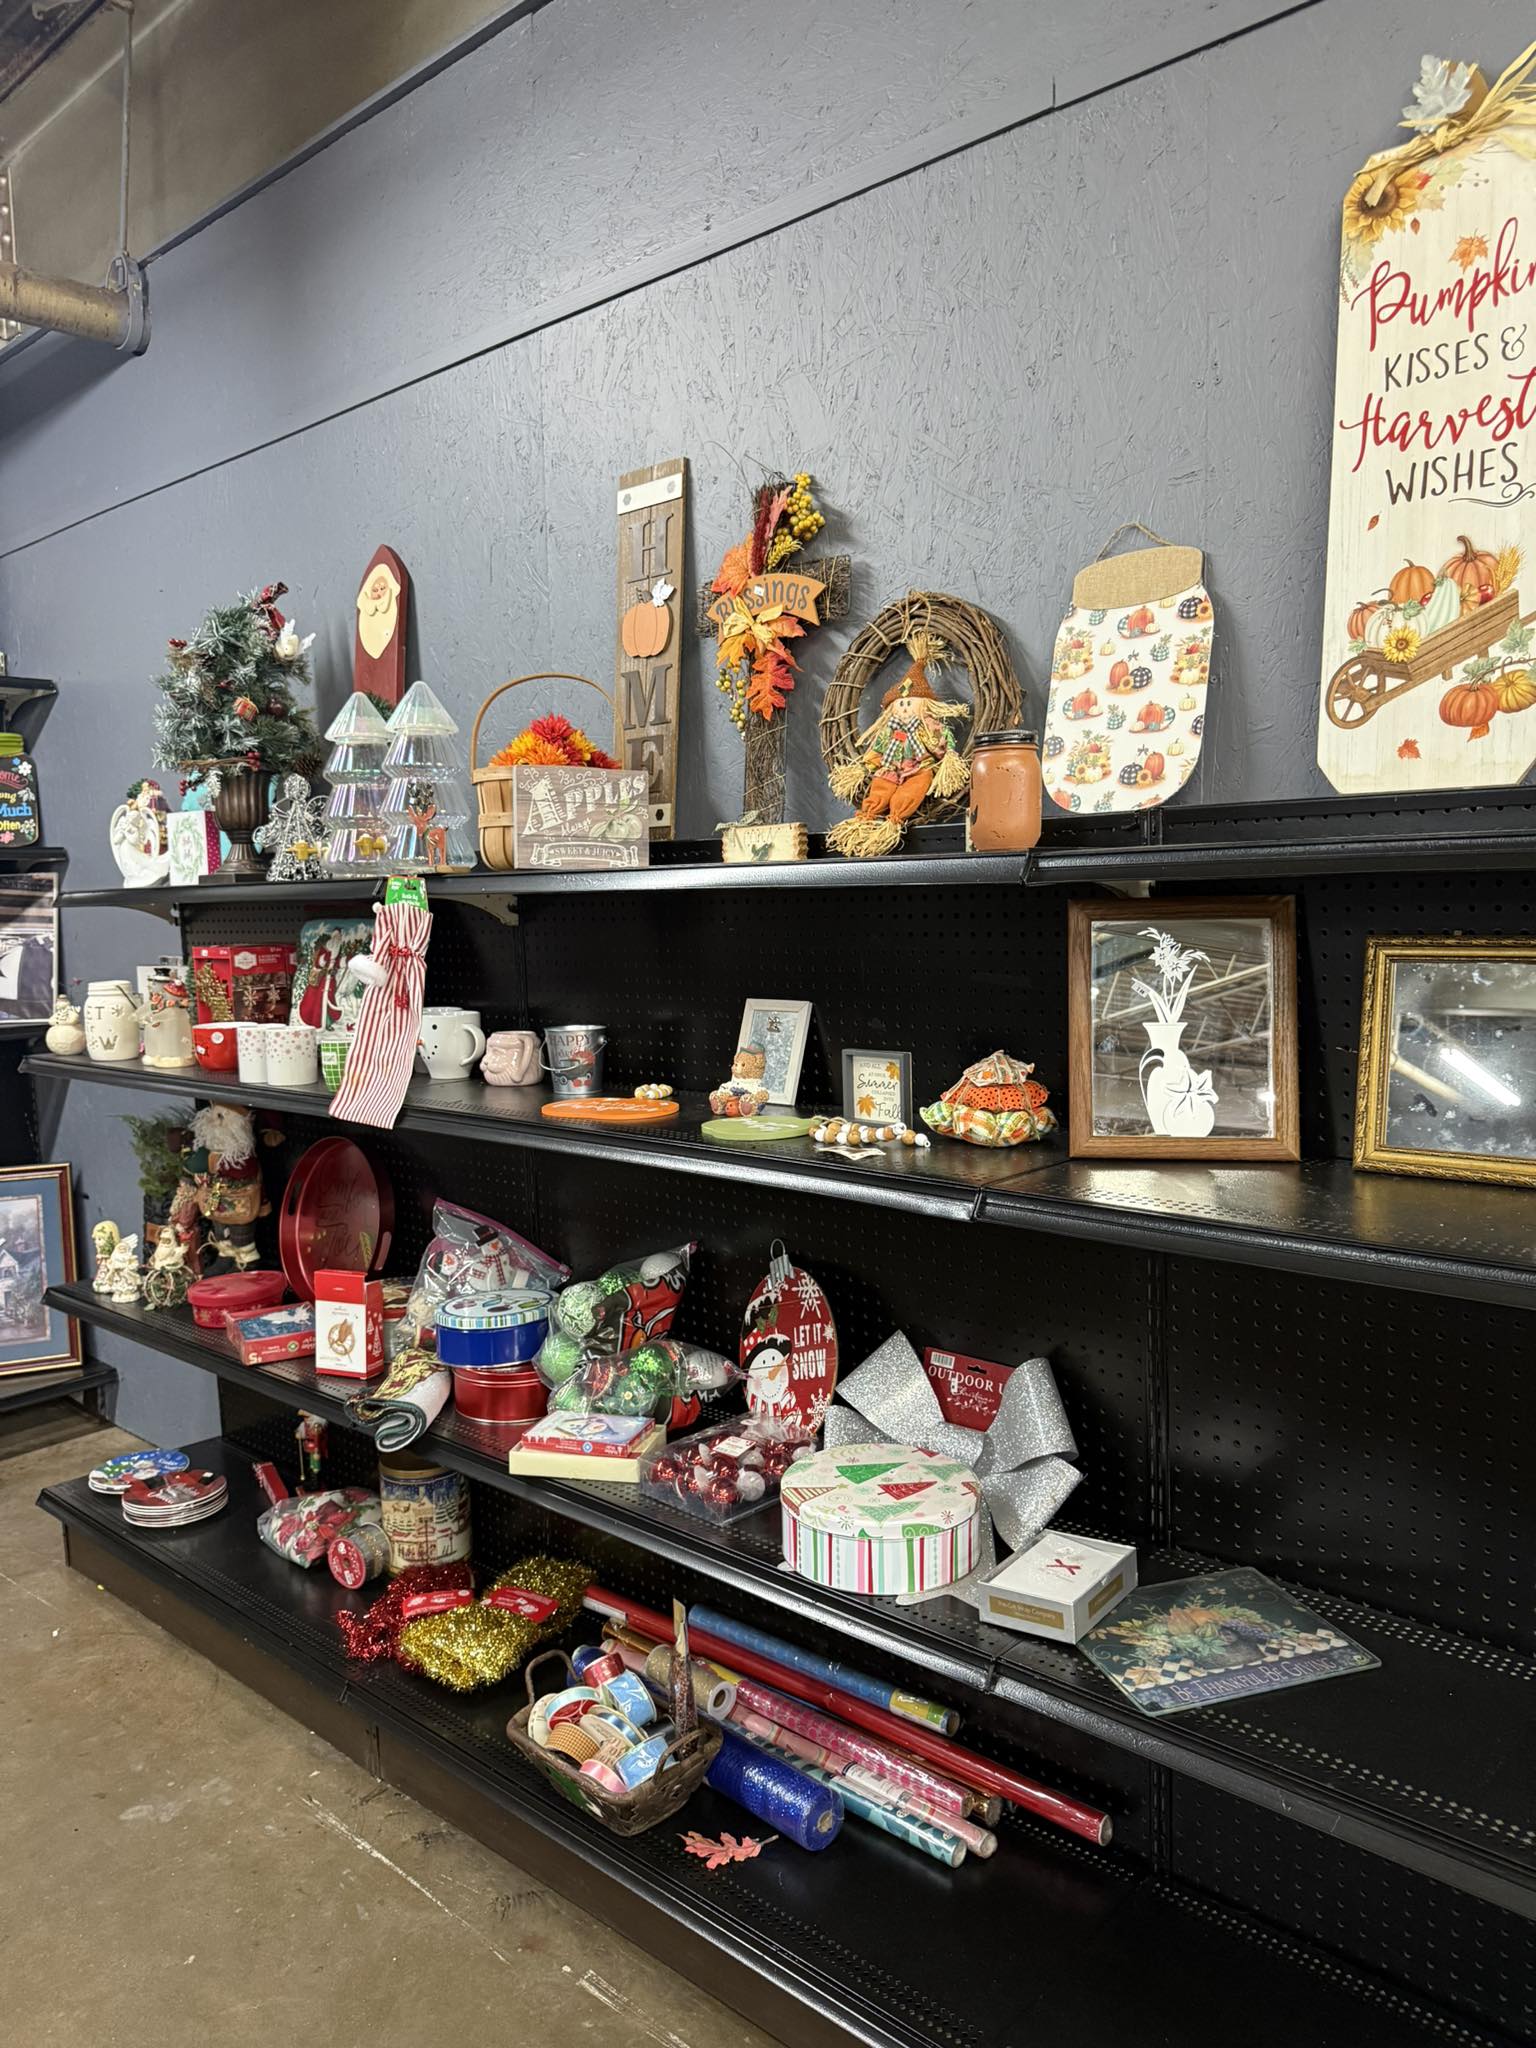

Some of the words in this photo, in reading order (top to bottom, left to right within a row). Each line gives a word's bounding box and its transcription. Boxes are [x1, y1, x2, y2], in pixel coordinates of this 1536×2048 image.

[1384, 333, 1488, 392] KISSES
[1501, 324, 1527, 361] &
[1340, 366, 1536, 473] Harvest
[1385, 441, 1519, 505] WISHES
[715, 577, 810, 620] Blssings
[522, 772, 646, 837] APPLES
[554, 847, 582, 856] SWEET
[591, 848, 616, 857] JUICY
[549, 1034, 591, 1047] HAPPY
[875, 1101, 902, 1120] Fall
[793, 1325, 810, 1348] LET
[812, 1322, 822, 1345] IT
[792, 1348, 827, 1381] SNOW
[928, 1365, 994, 1393] OUTDOOR
